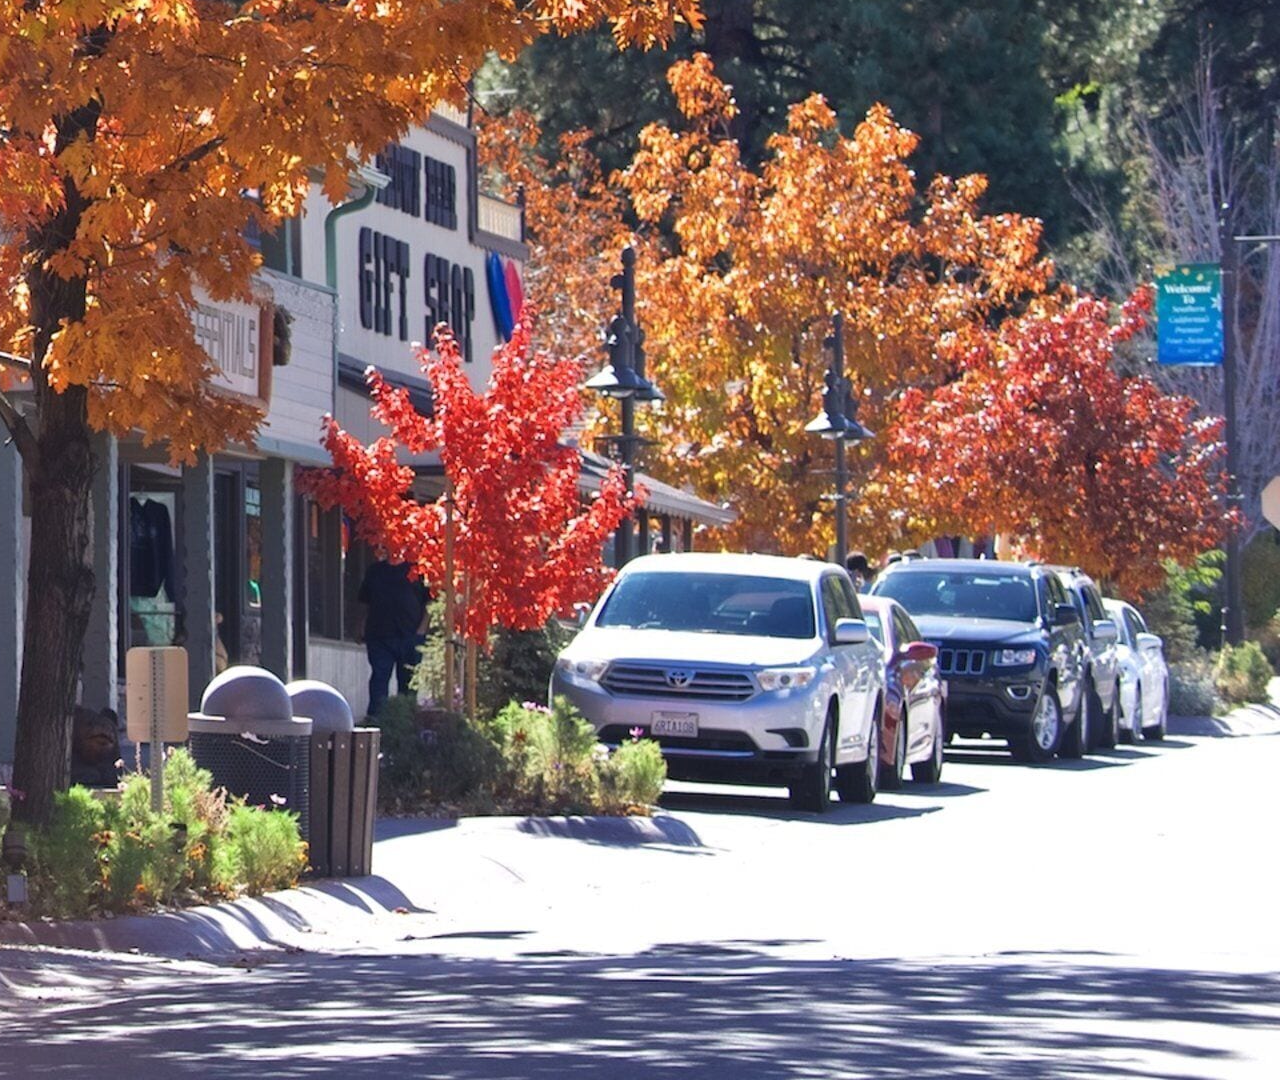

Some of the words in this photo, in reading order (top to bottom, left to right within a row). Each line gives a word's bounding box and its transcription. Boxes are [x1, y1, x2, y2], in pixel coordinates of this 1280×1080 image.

[359, 226, 410, 341] GIFT
[424, 252, 475, 363] SHOP
[1164, 282, 1212, 294] Welcome
